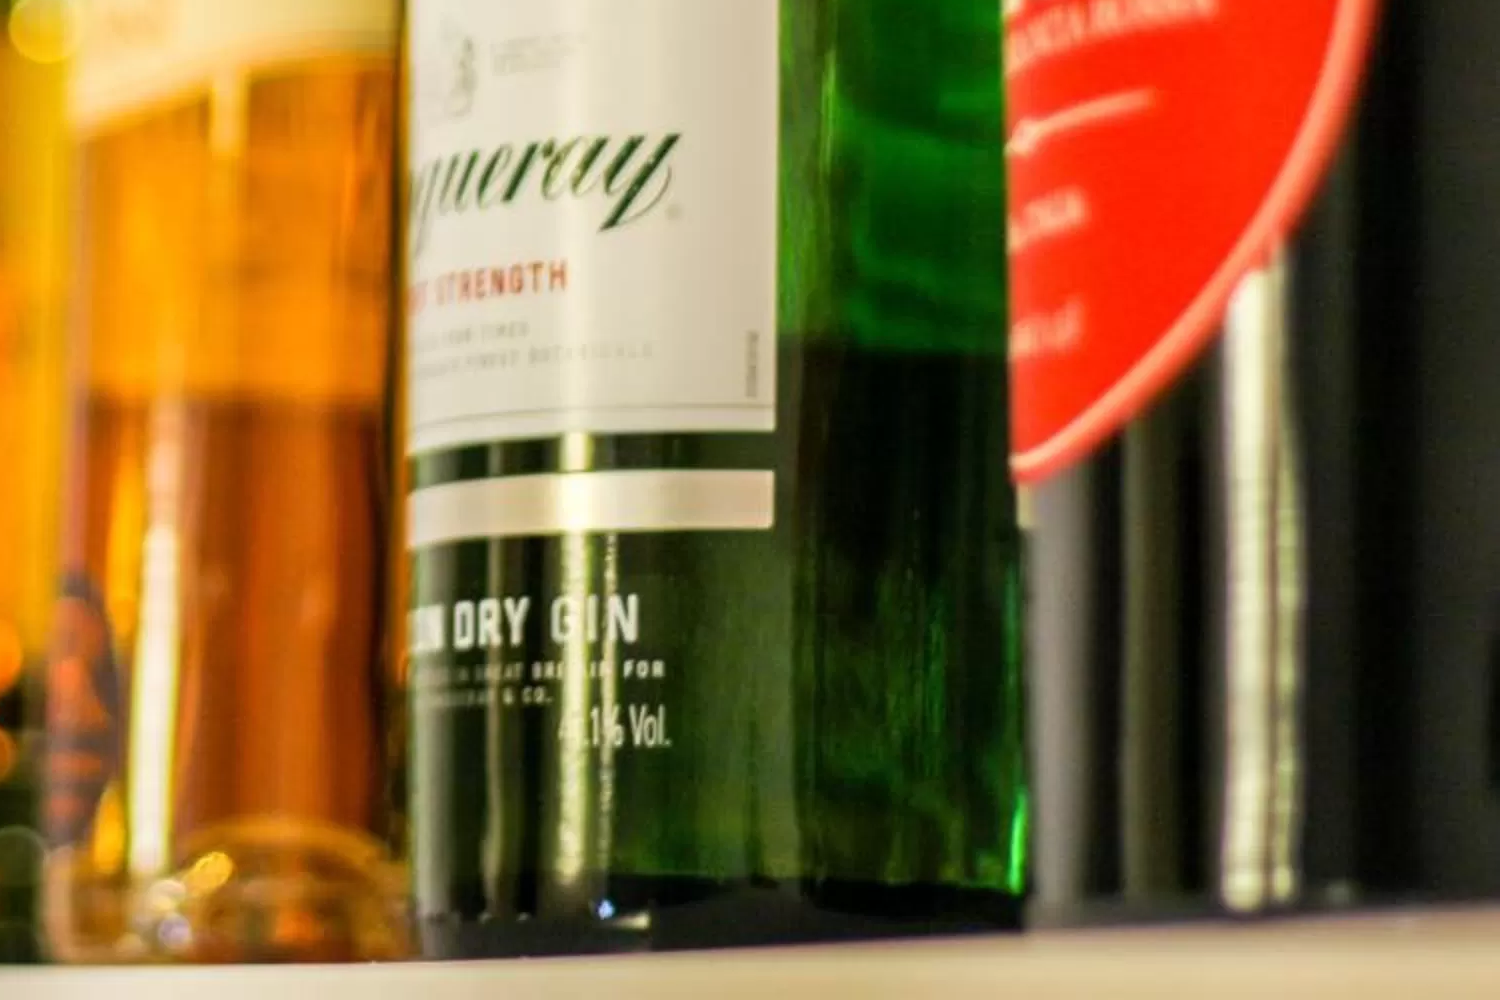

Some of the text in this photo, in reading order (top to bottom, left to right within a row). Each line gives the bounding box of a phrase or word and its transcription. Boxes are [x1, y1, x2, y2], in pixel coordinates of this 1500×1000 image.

[435, 260, 567, 305] STRENGTH
[453, 596, 531, 650] DRY
[550, 593, 640, 645] GIN
[623, 659, 666, 679] FOR
[628, 703, 672, 747] Vol.
